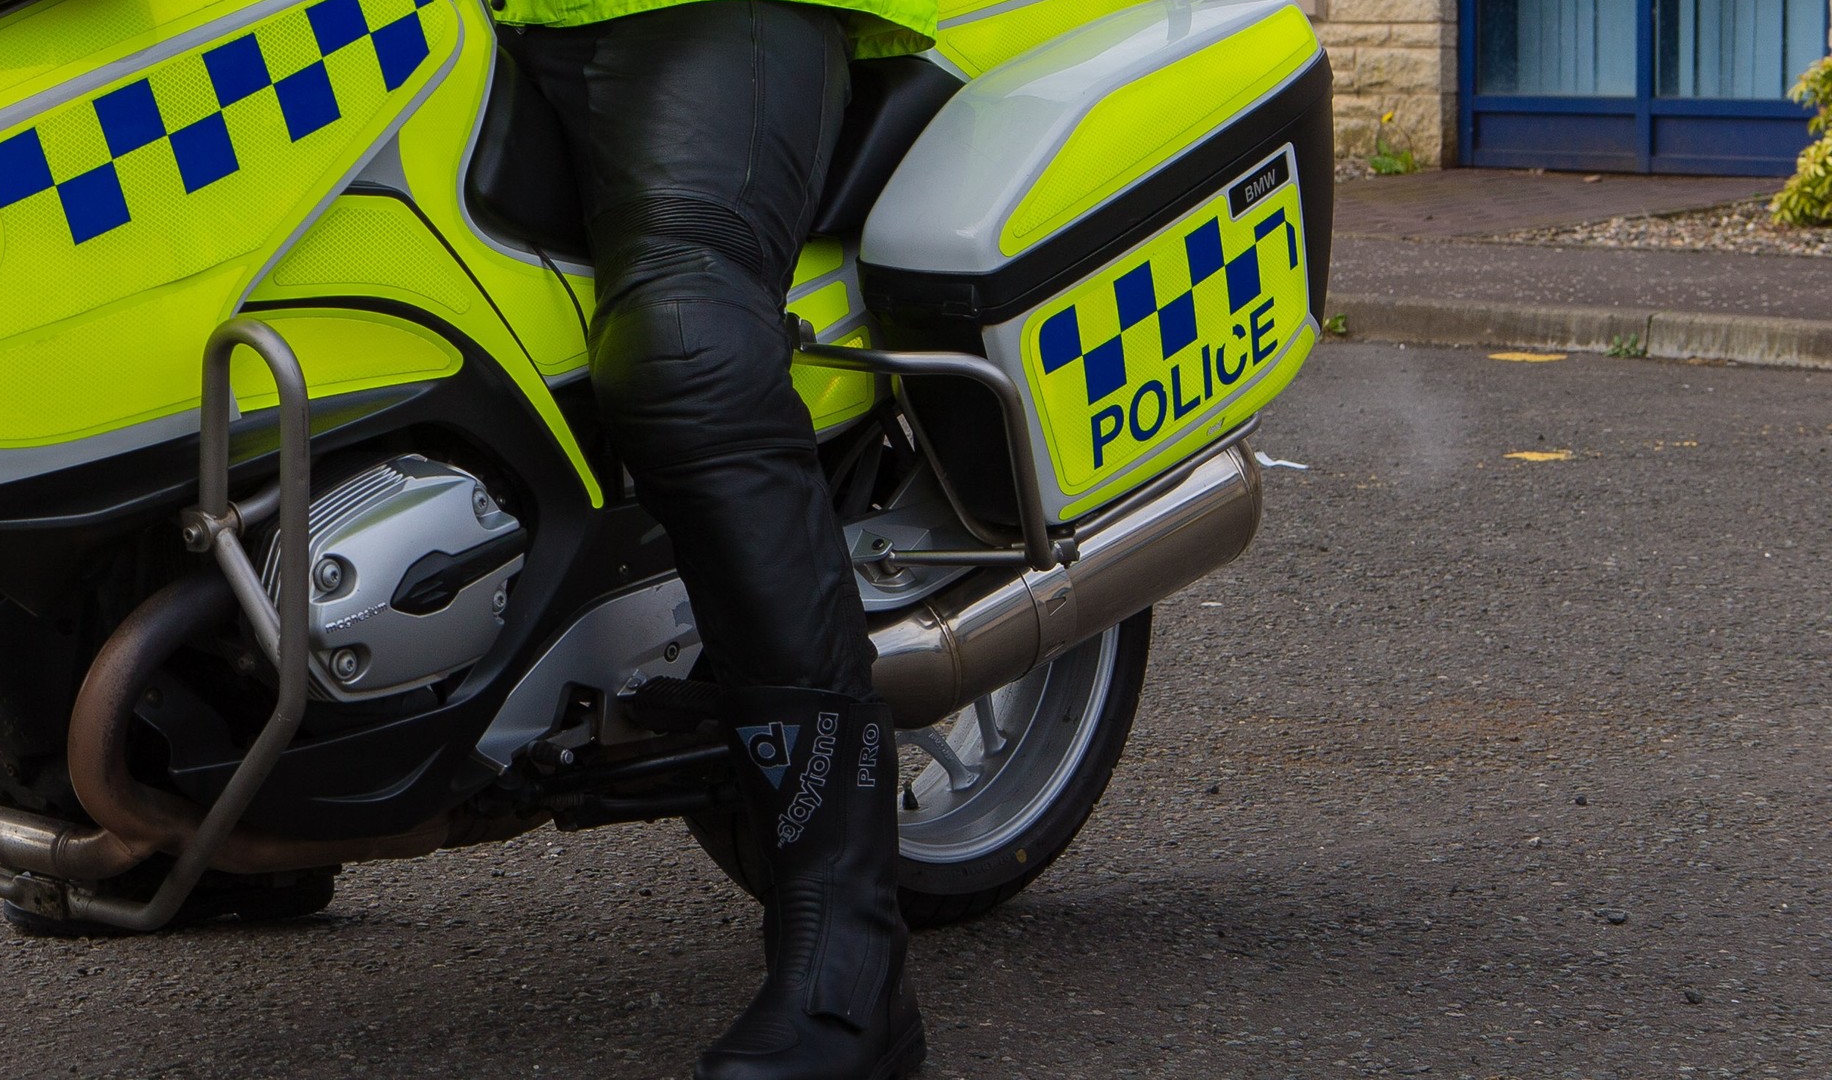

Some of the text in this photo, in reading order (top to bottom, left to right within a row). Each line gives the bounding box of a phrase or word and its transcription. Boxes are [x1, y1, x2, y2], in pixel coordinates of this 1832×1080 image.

[1244, 169, 1277, 204] BMW
[1090, 296, 1279, 471] POLICE
[325, 602, 388, 633] magnesium
[777, 711, 839, 843] daytona
[856, 723, 880, 788] PRO
